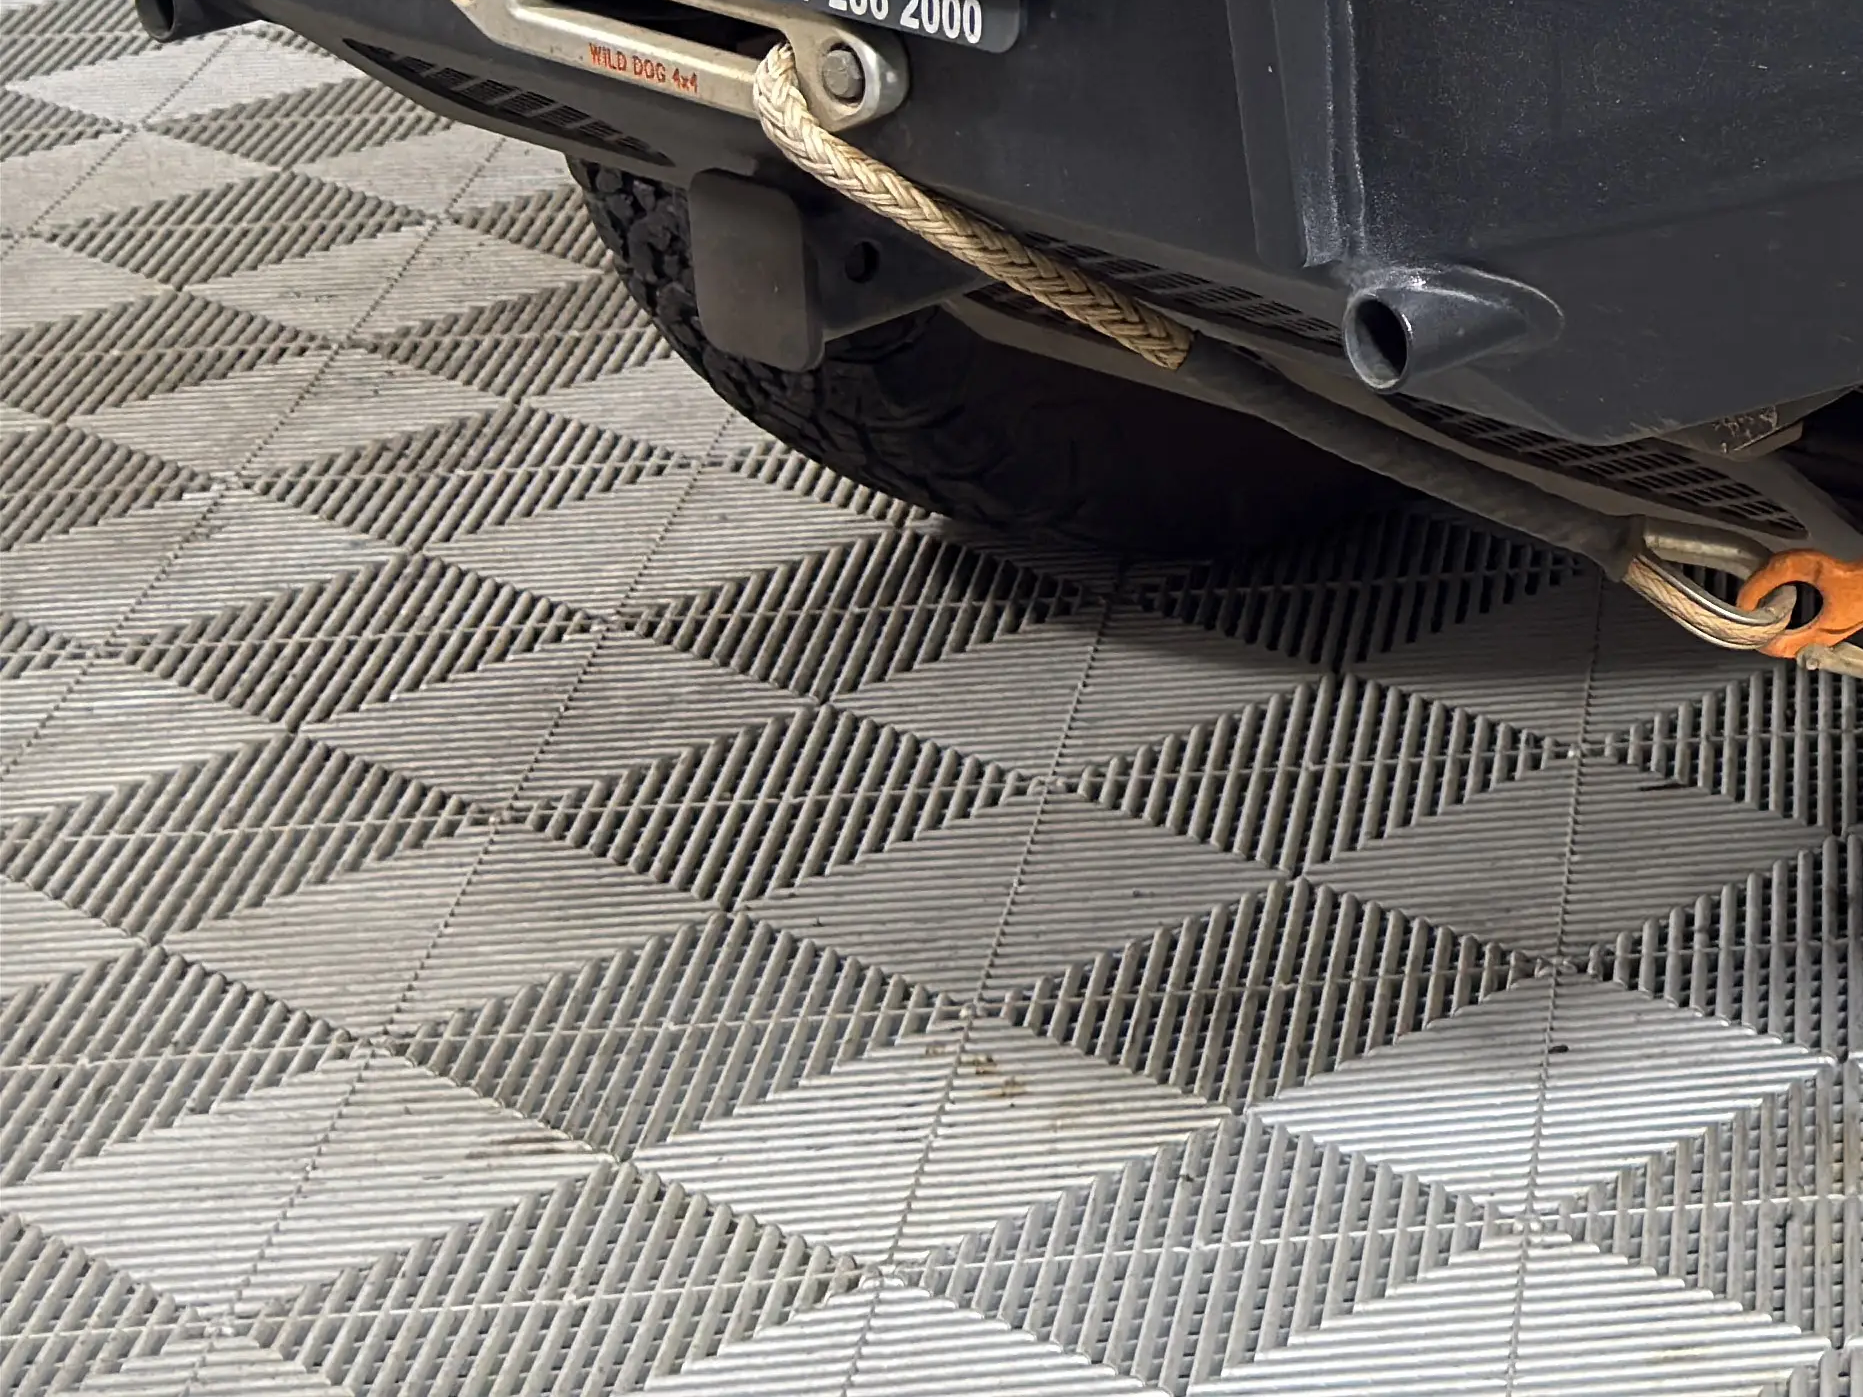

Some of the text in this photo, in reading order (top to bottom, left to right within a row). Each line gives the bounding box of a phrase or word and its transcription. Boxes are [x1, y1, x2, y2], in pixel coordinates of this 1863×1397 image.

[588, 42, 698, 94] WILD DOG 4x4
